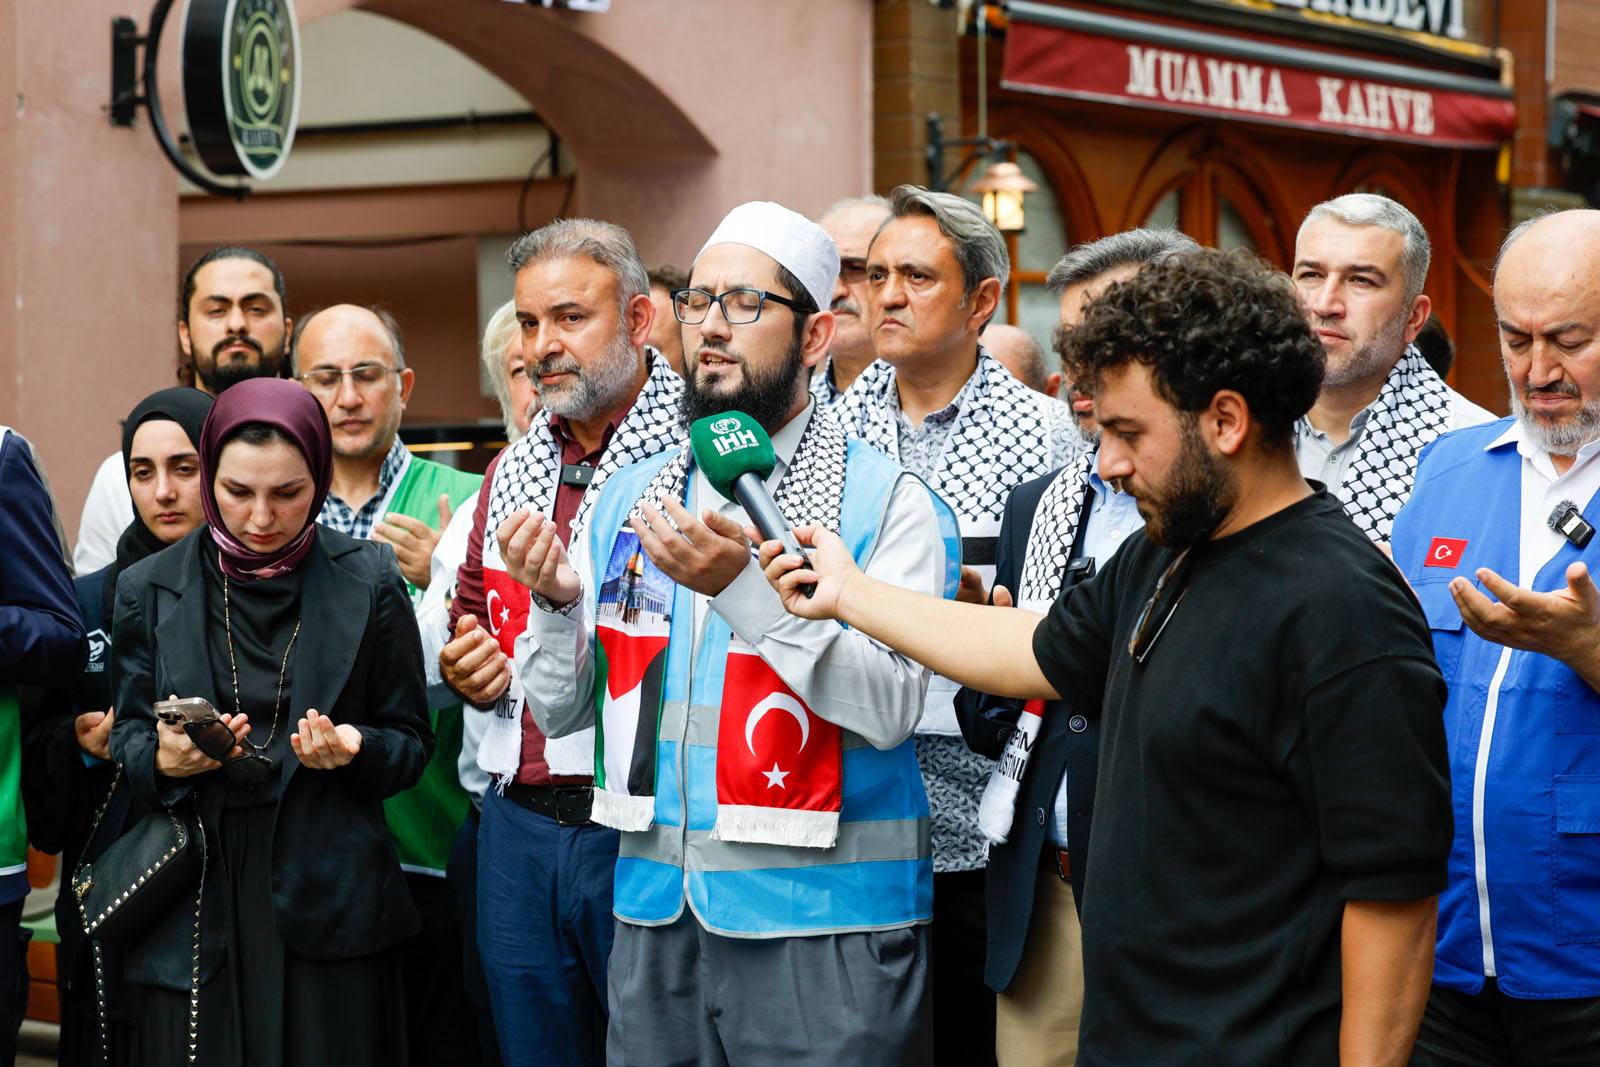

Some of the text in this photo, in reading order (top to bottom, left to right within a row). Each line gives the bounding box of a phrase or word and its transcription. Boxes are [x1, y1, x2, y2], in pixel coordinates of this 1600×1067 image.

[1126, 46, 1434, 135] MUAMMA KAHVE
[712, 429, 758, 453] IHH
